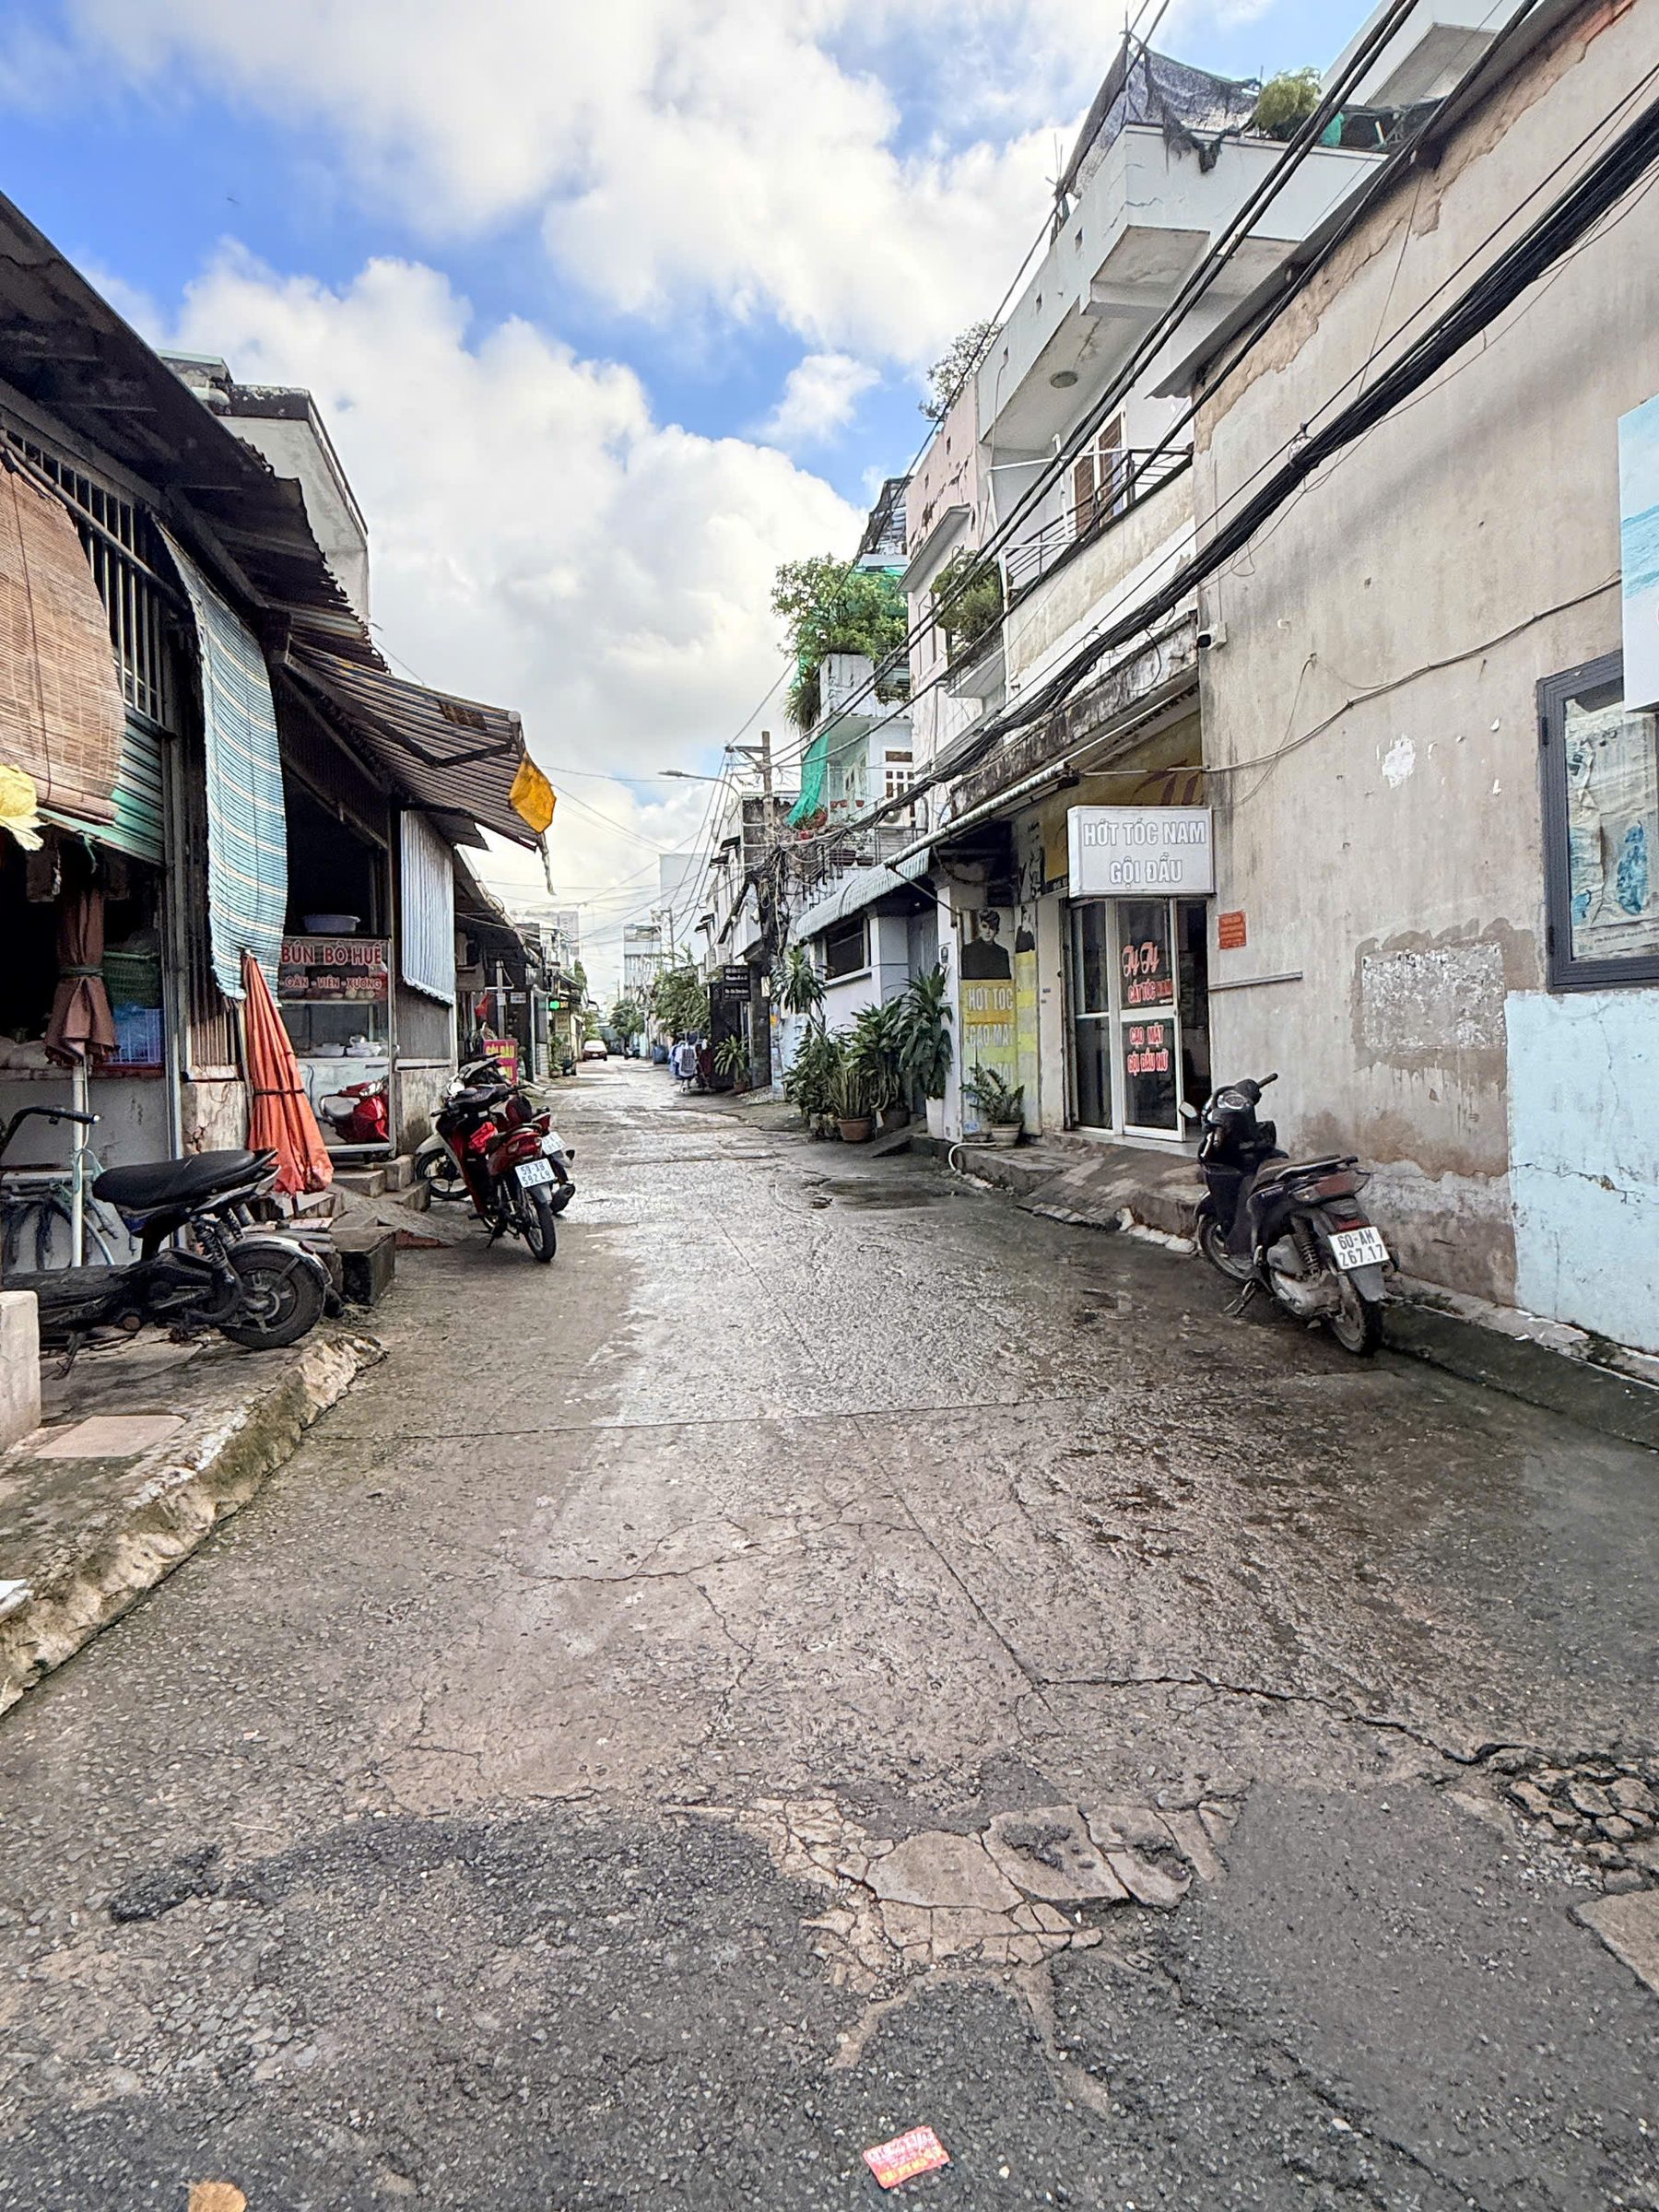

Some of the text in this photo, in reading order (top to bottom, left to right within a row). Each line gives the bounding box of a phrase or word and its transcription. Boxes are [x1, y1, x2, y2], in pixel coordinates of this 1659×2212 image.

[1084, 818, 1206, 846] HỚT TÓC NAM
[1110, 855, 1141, 888] GỘI
[281, 940, 384, 966] BÚN BÒ HUẾ
[1337, 1229, 1375, 1250] 60-AH
[1338, 1243, 1383, 1267] 267.17
